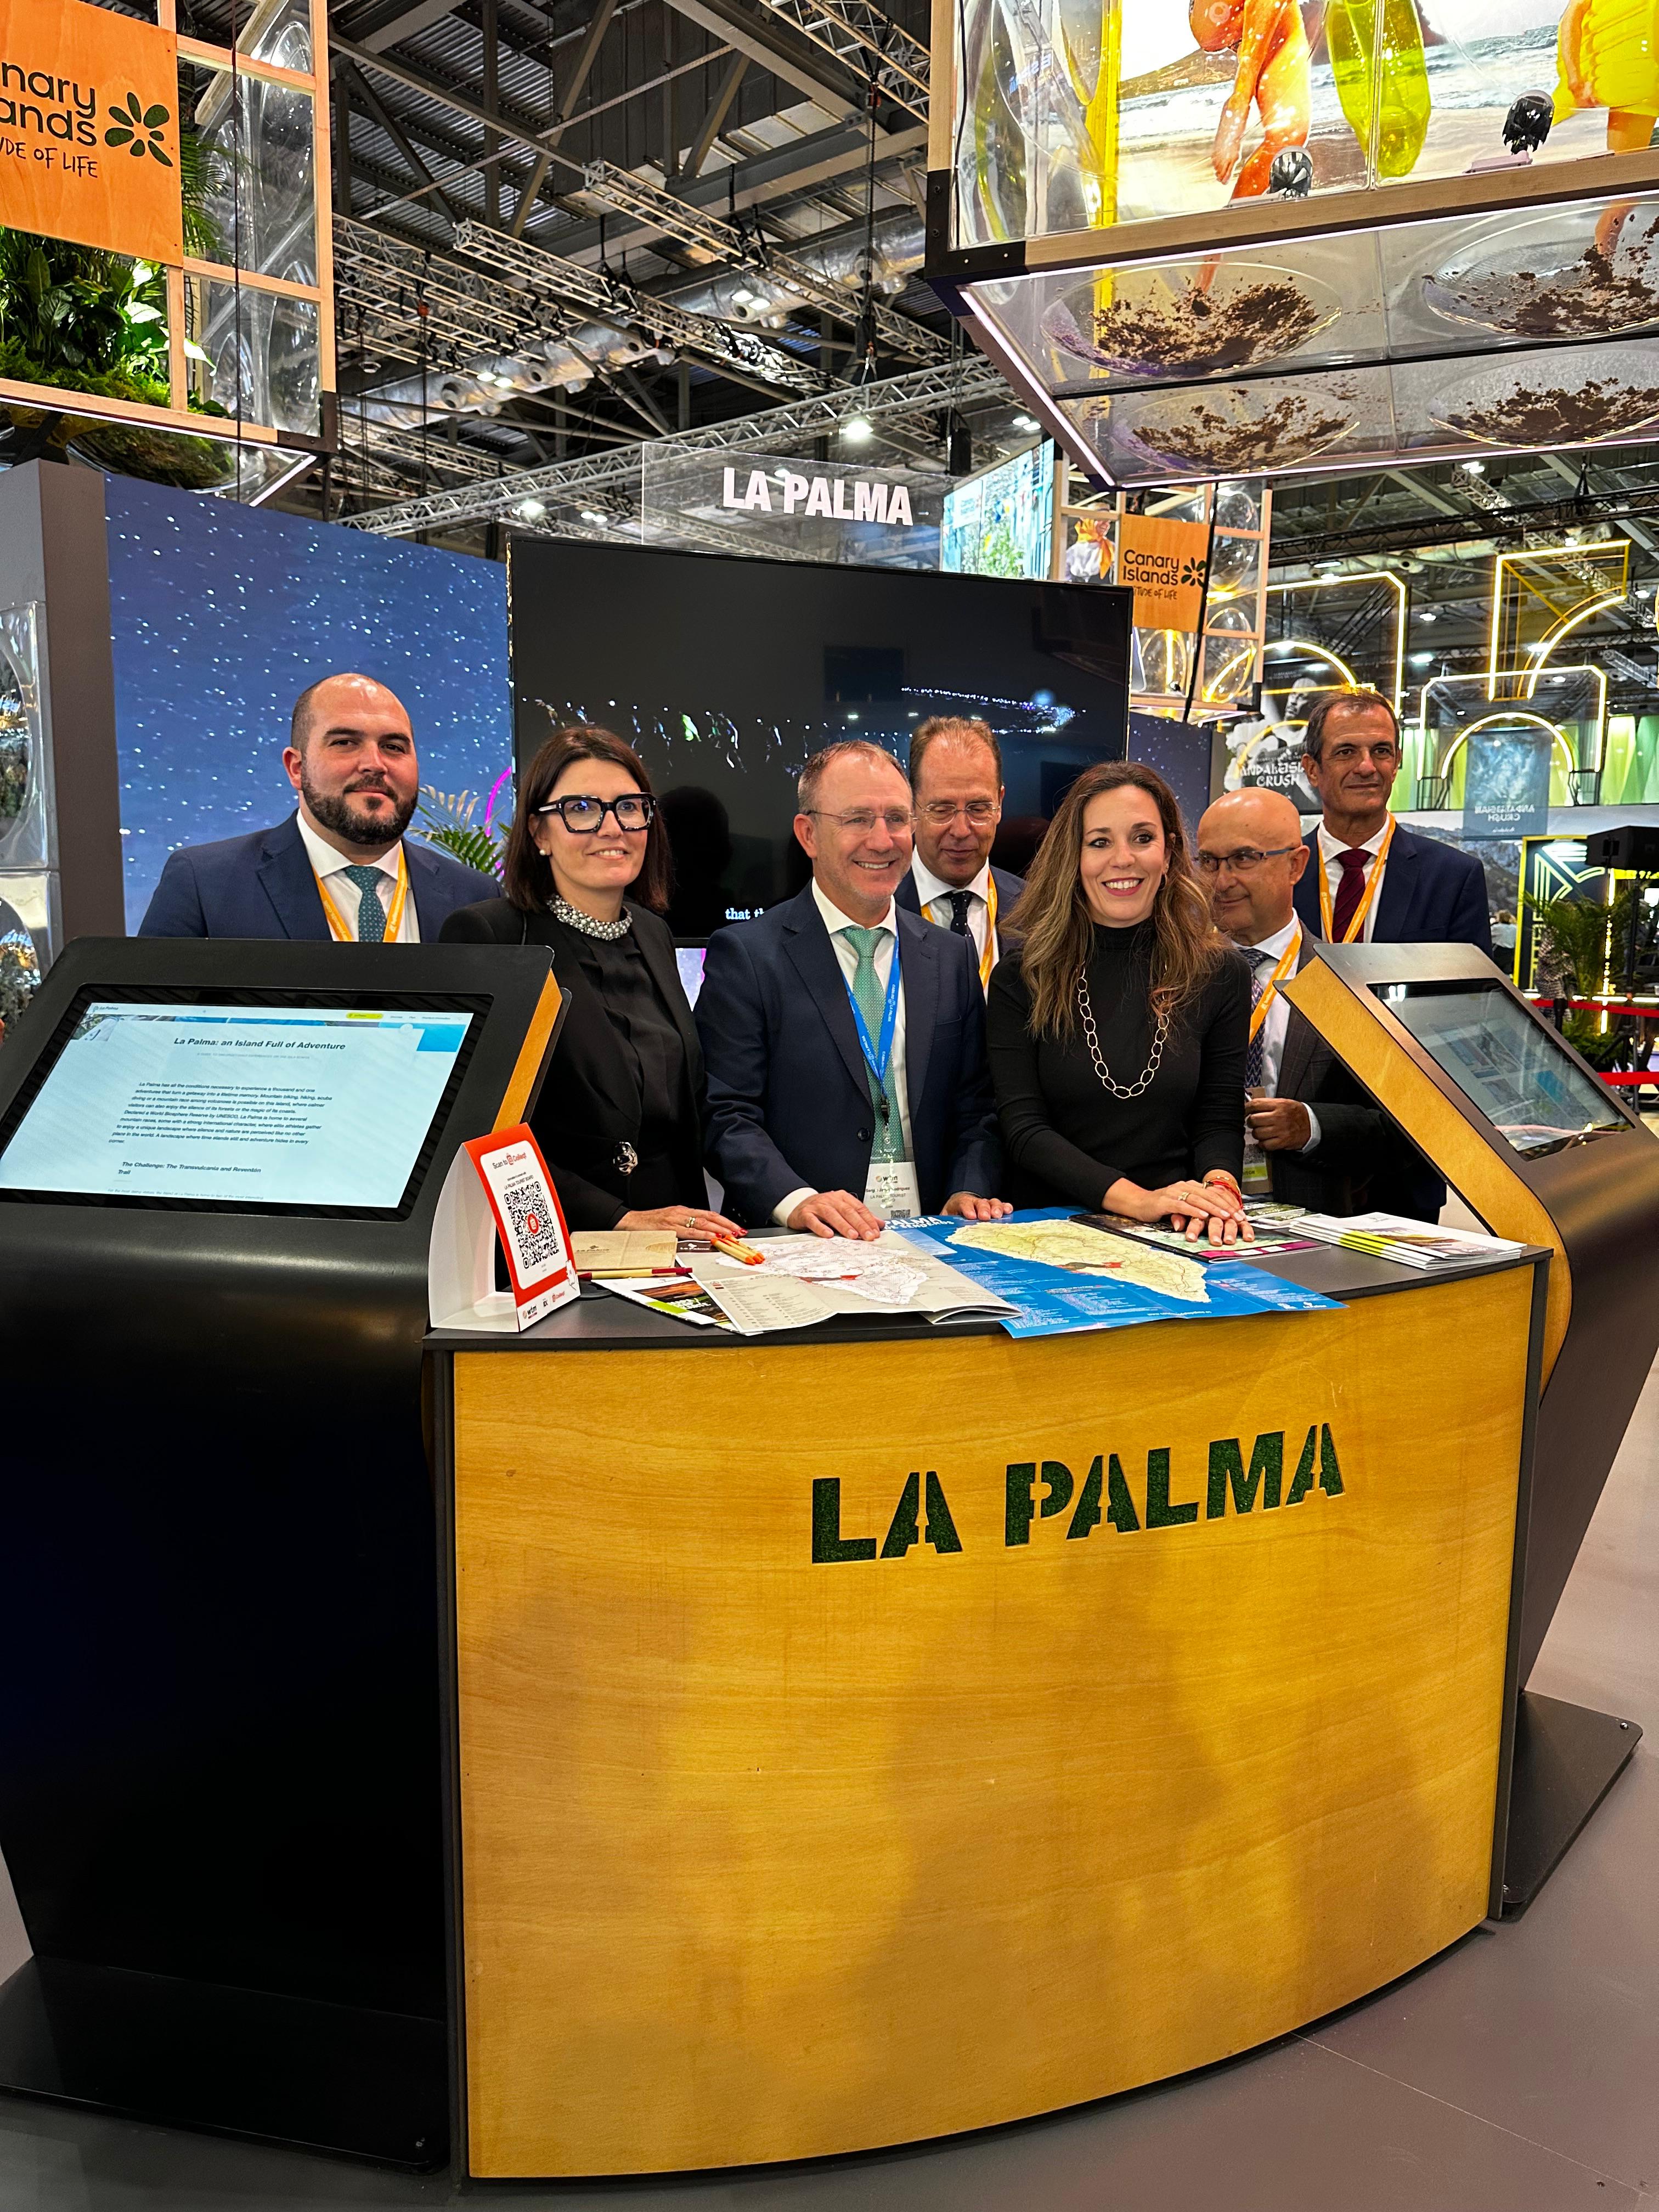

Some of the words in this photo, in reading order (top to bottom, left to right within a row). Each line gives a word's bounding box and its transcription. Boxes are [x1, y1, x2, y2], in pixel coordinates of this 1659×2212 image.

[33, 148, 58, 169] OF
[63, 151, 98, 178] LIFE
[723, 466, 772, 512] LA
[783, 473, 914, 527] PALMA
[1124, 549, 1180, 573] Canary
[1123, 566, 1178, 586] Islands
[1164, 589, 1177, 600] LIFE
[1256, 774, 1300, 787] CRUSH
[725, 907, 751, 920] that
[492, 1161, 504, 1169] Scan
[884, 1216, 942, 1226] PALMA
[527, 1305, 537, 1316] wtm
[811, 1469, 963, 1565] LA
[1005, 1421, 1346, 1549] PALMA
